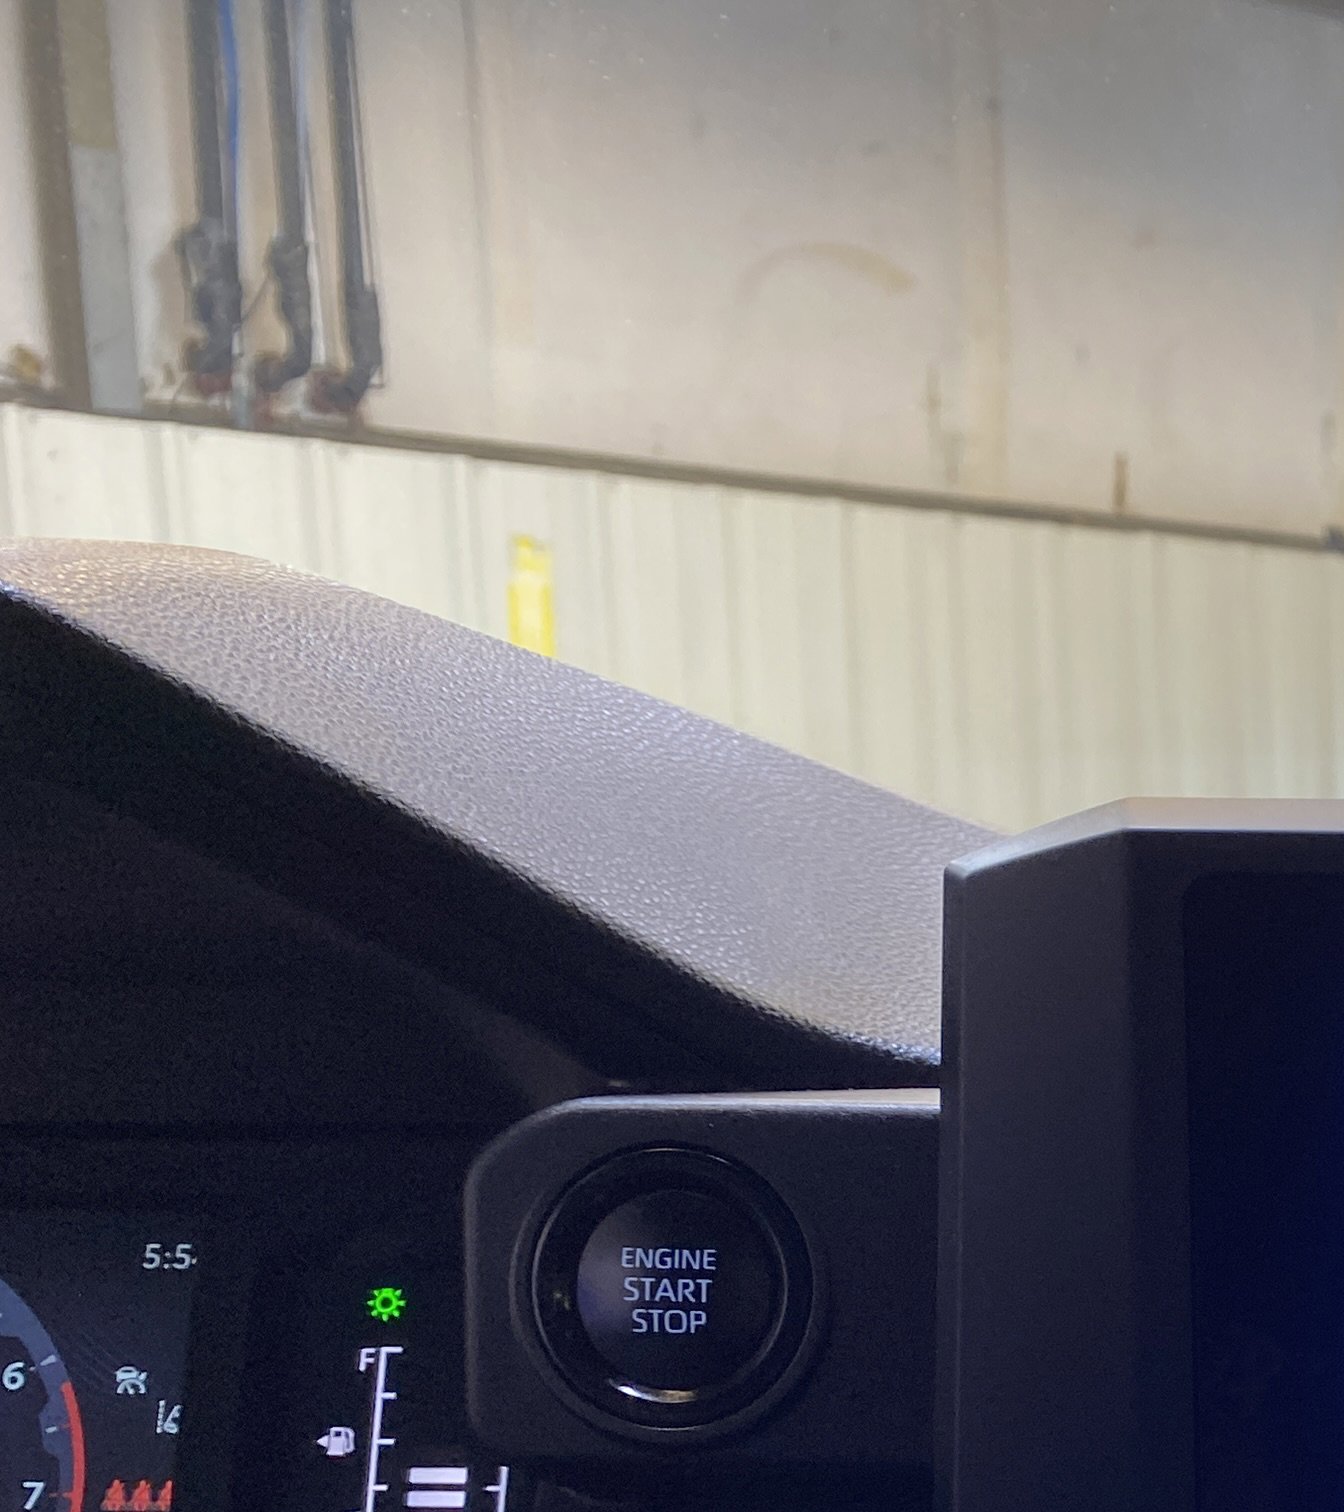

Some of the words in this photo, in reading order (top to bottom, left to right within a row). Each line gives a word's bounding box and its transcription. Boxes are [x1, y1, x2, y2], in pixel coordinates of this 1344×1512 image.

[142, 1243, 198, 1270] 5:5
[621, 1247, 717, 1270] ENGINE
[623, 1277, 713, 1303] START
[631, 1308, 707, 1334] STOP
[359, 1348, 377, 1372] F
[2, 1361, 25, 1391] 6
[22, 1481, 45, 1511] 7
